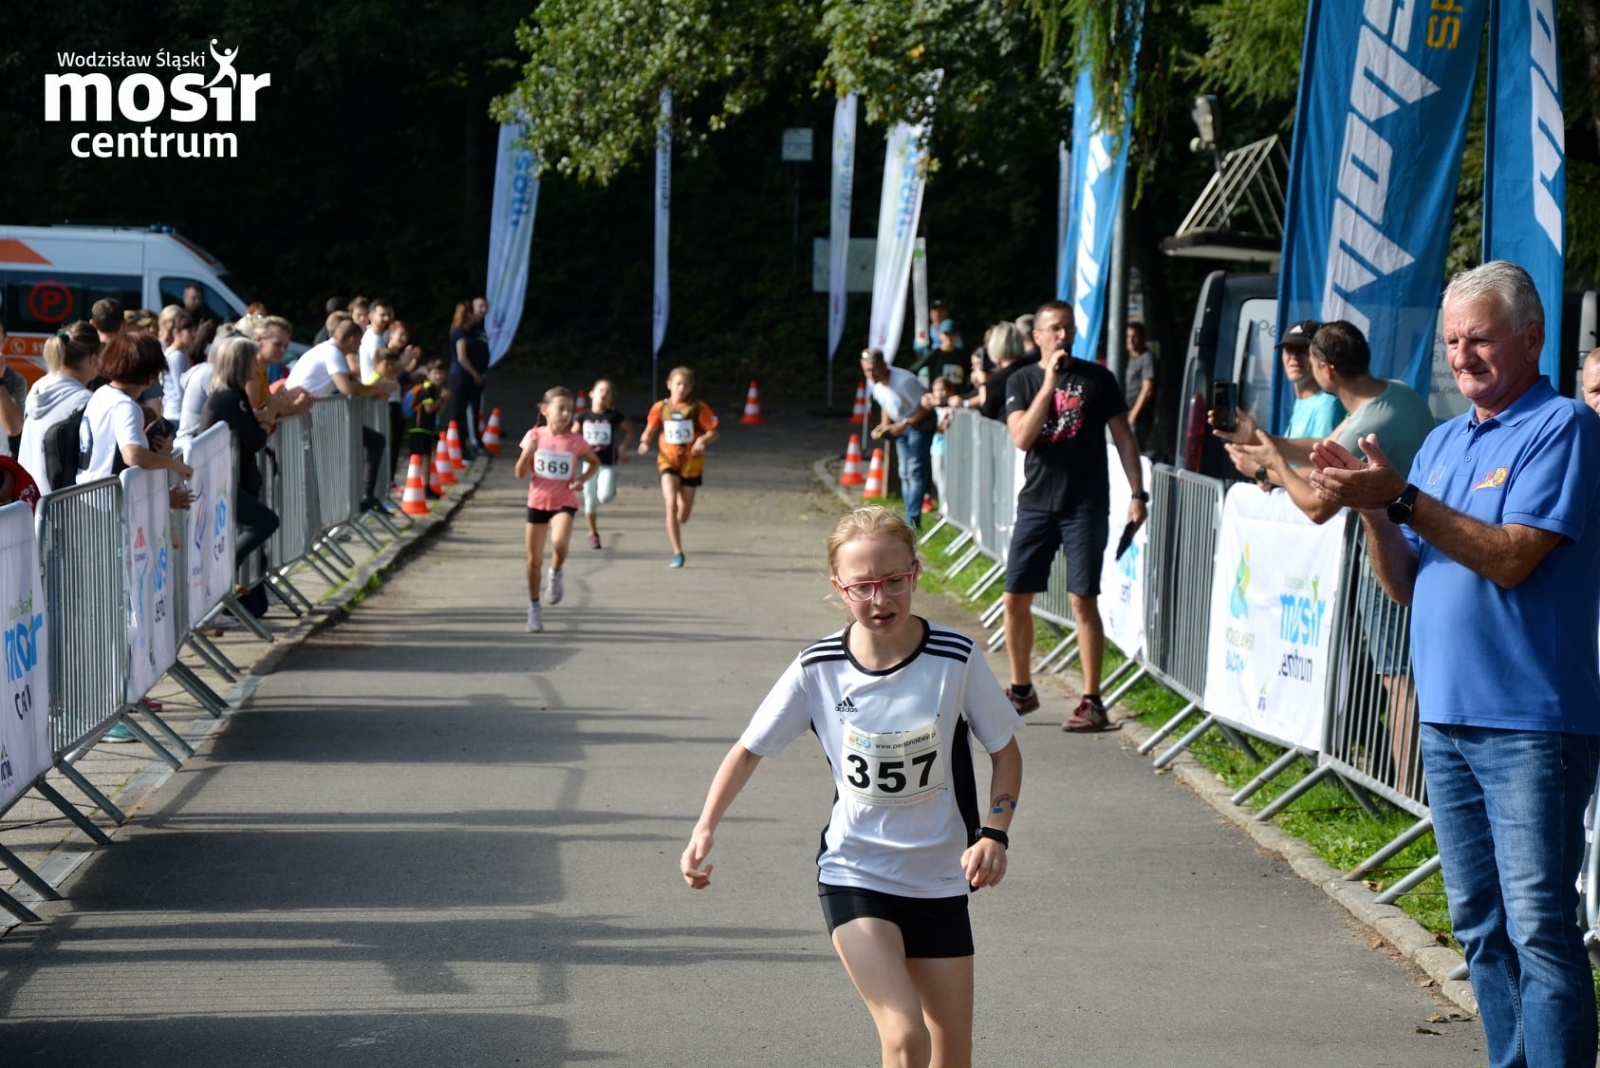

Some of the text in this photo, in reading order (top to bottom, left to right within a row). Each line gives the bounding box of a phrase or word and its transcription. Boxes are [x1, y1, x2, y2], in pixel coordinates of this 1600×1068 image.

[1257, 320, 1277, 337] Pe
[536, 459, 569, 475] 369
[835, 705, 858, 713] adidas
[847, 750, 938, 793] 357
